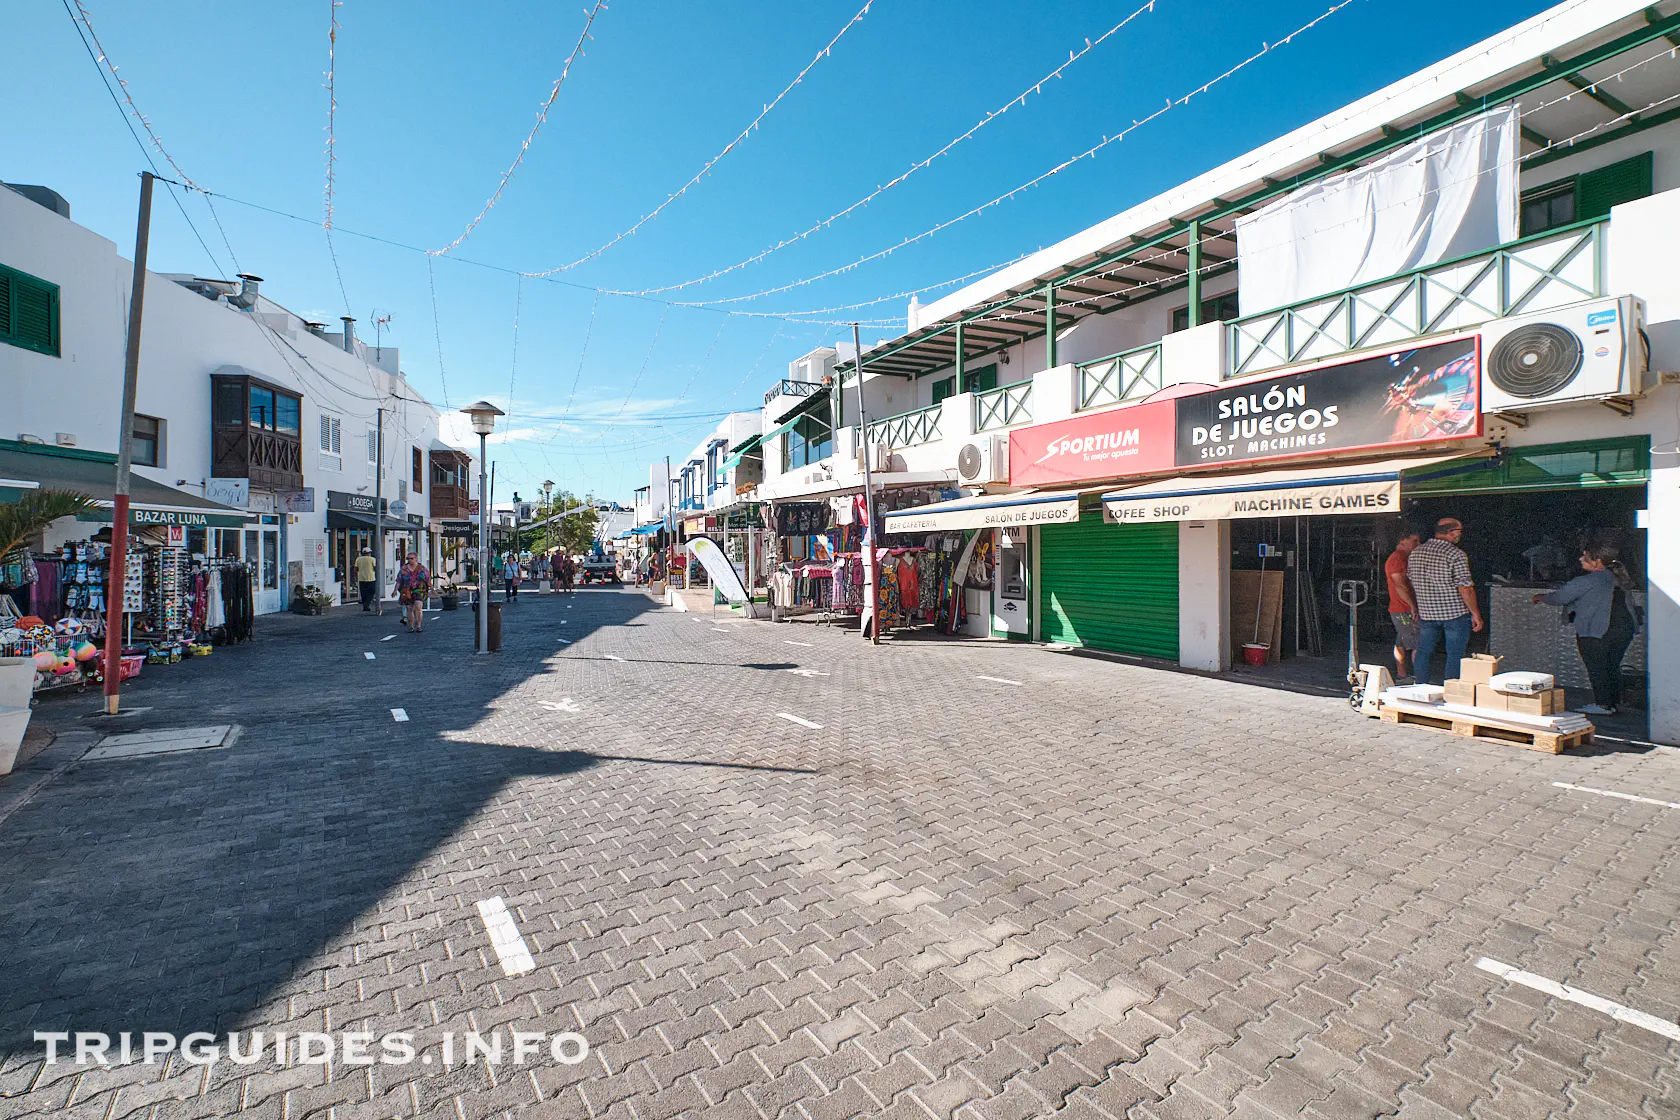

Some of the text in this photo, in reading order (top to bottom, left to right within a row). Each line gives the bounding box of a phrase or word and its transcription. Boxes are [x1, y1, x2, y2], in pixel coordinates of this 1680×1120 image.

[1218, 384, 1307, 420] SALÓN
[1192, 405, 1340, 446] DE JUEGOS
[1035, 428, 1140, 465] SPORTIUM
[1200, 432, 1326, 459] SLOT MACHINES
[1082, 447, 1139, 462] Tu mejor apuesta
[352, 497, 374, 508] BODEGA
[1153, 505, 1191, 517] SHOP
[1234, 493, 1390, 512] MACHINE GAMES
[135, 511, 207, 525] BAZAR LUNA
[985, 508, 1068, 524] SALÓN DE JUEGOS
